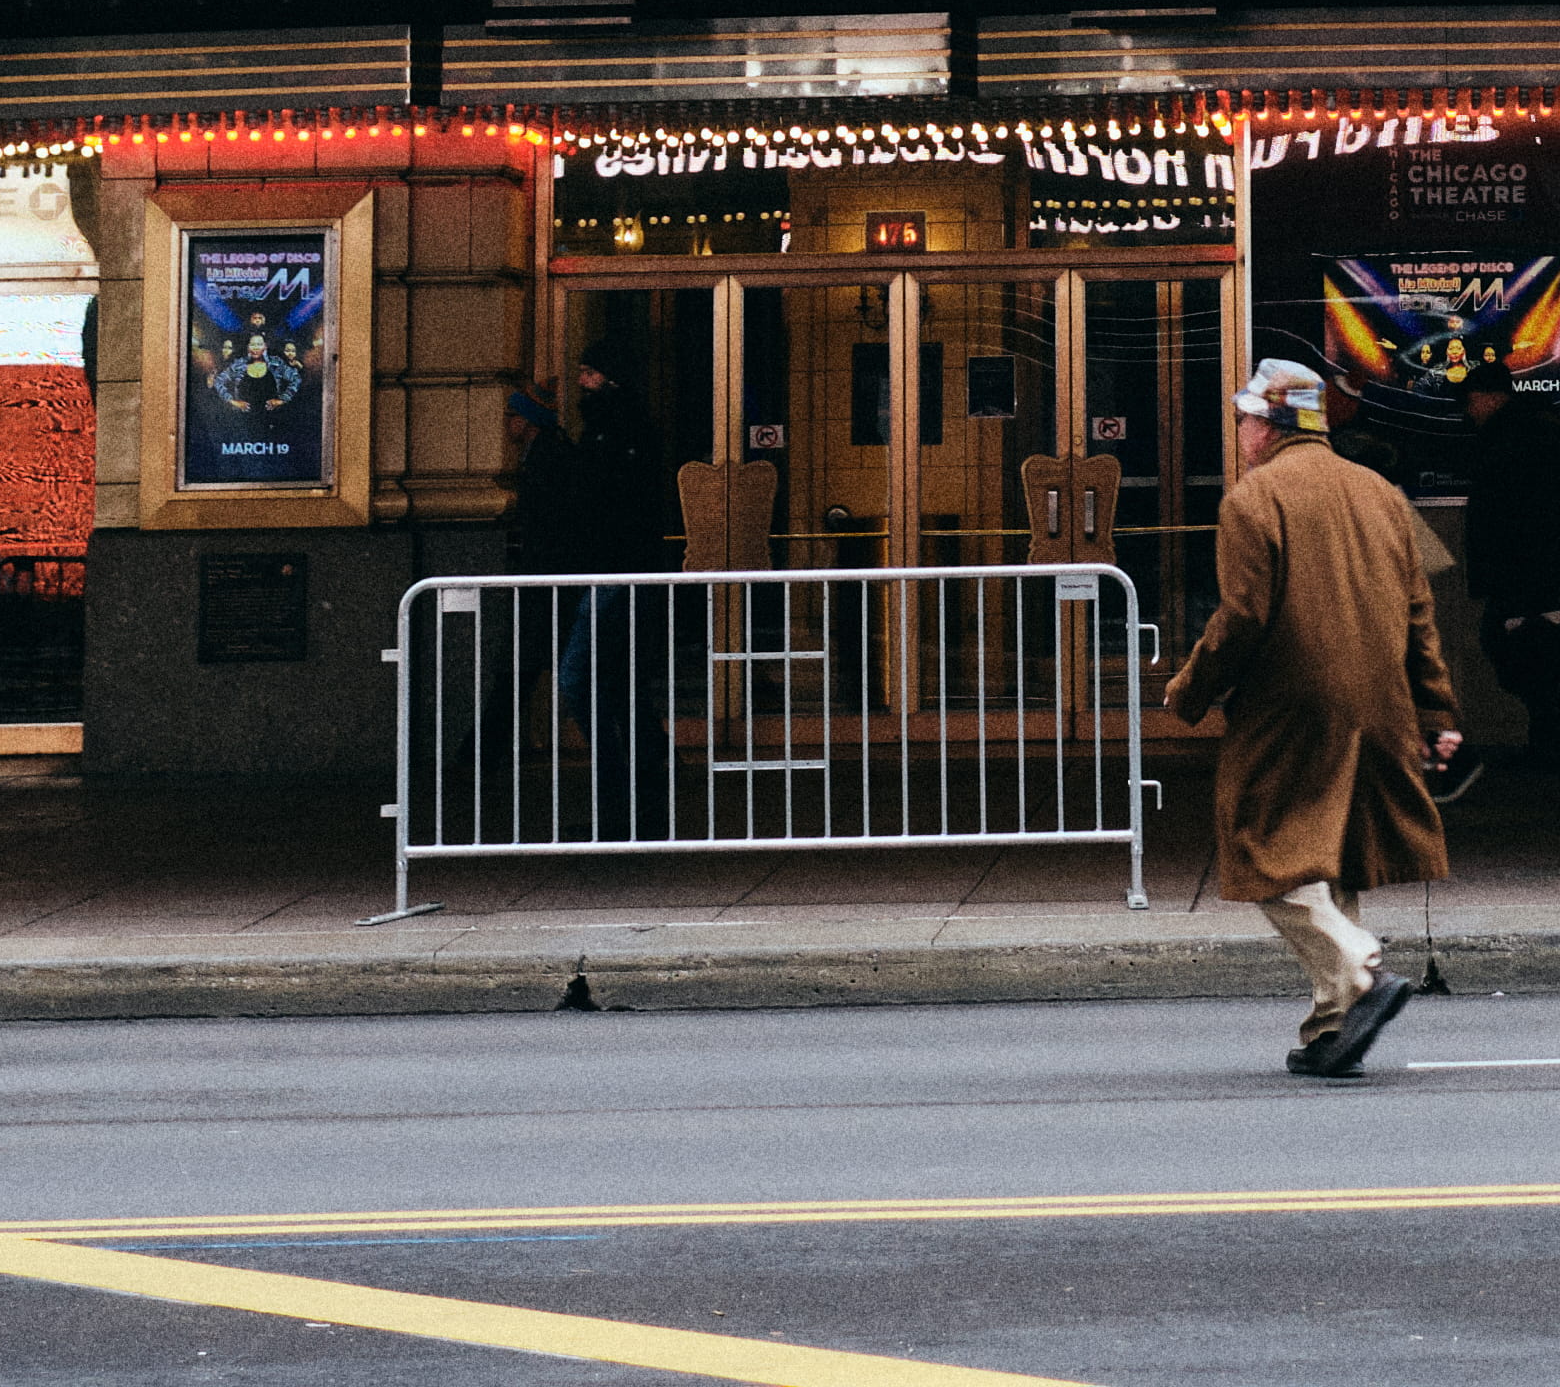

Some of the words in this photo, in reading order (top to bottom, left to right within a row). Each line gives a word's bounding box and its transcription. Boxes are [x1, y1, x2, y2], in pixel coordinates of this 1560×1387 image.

[1408, 148, 1441, 162] THE
[1407, 163, 1528, 183] CHICAGO
[1409, 184, 1527, 206] THEATRE
[1455, 209, 1507, 222] CHASE
[199, 253, 222, 265] THE
[286, 253, 321, 263] DISCO
[1512, 380, 1560, 392] MARCH
[221, 442, 274, 455] MARCH
[276, 443, 290, 455] 19
